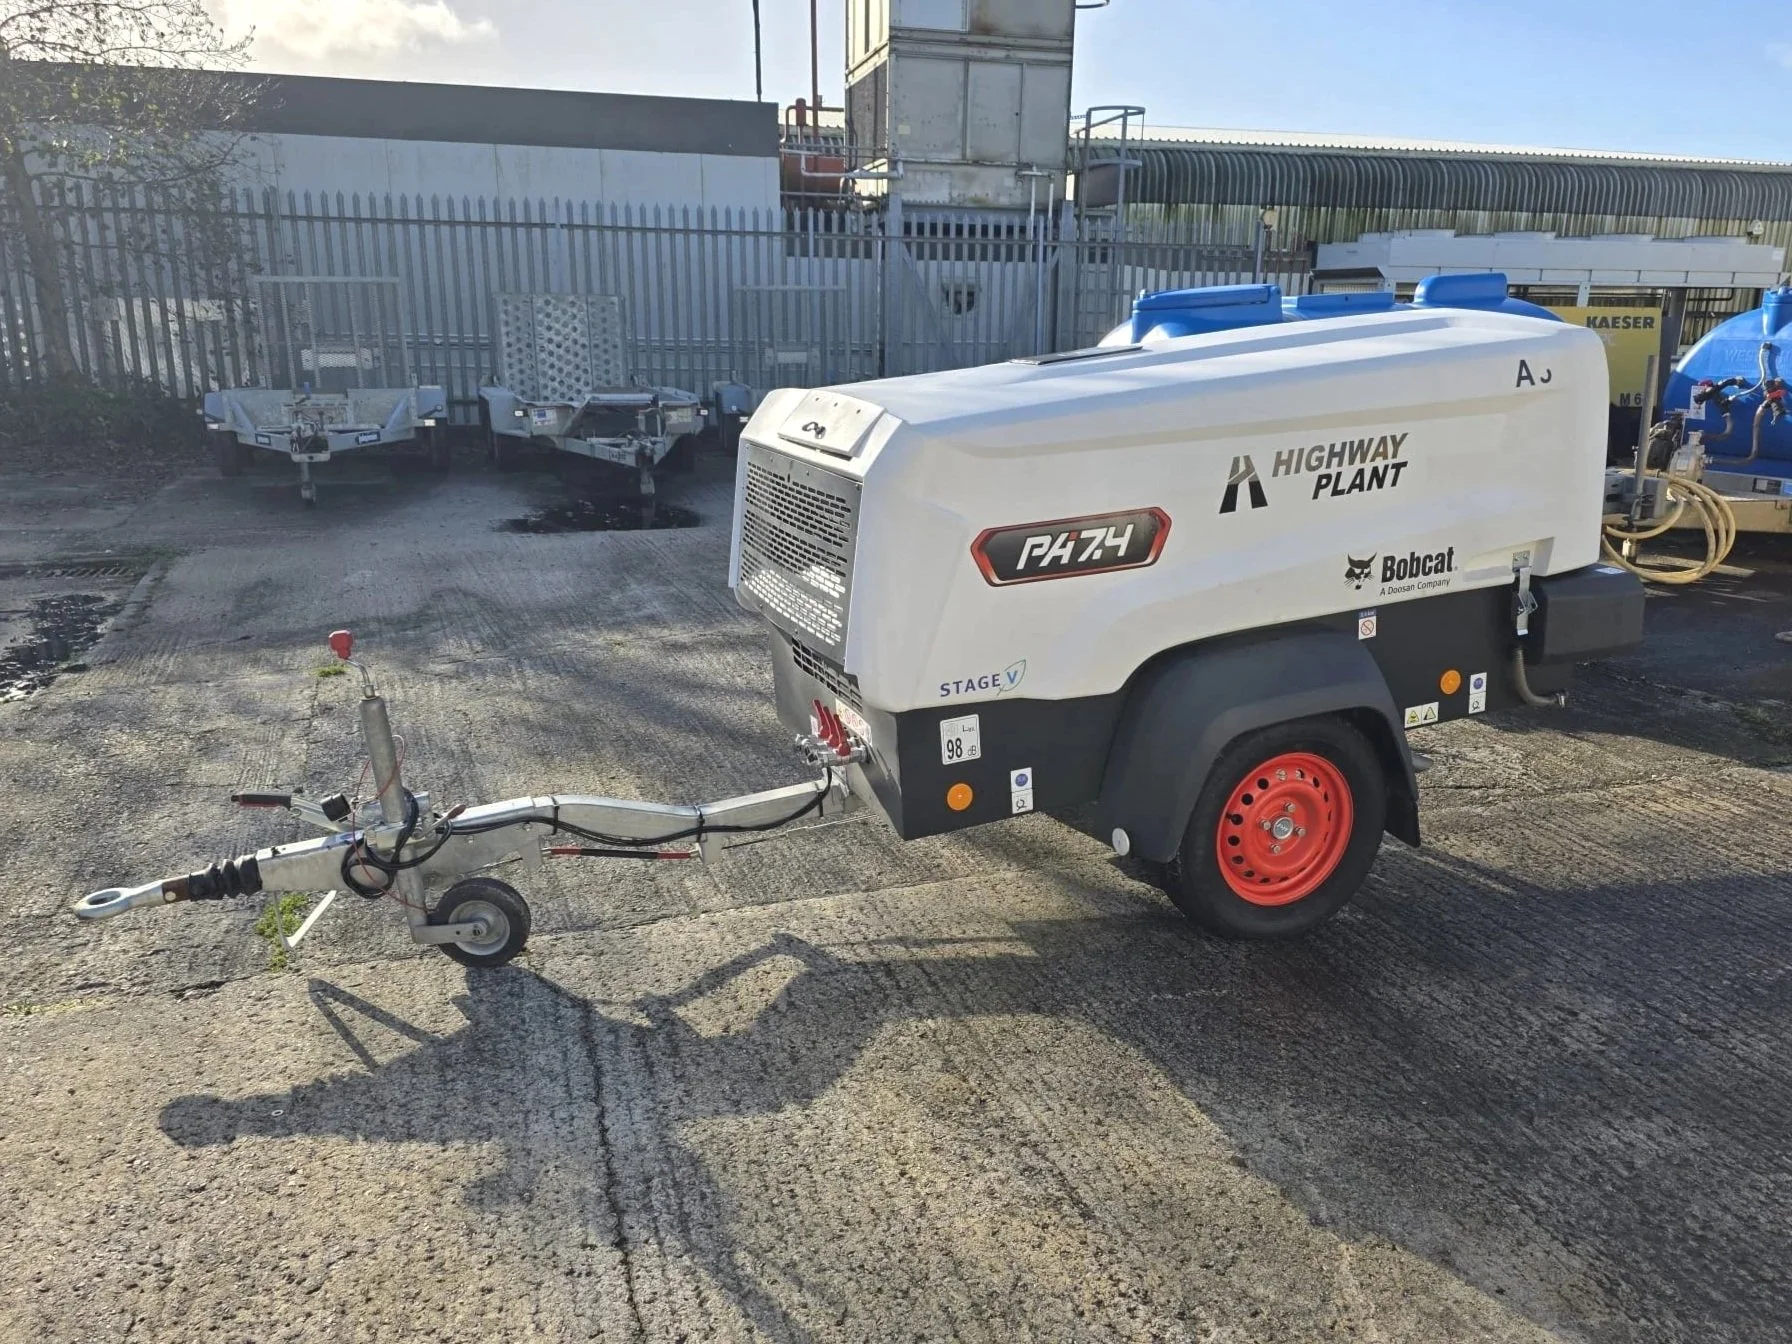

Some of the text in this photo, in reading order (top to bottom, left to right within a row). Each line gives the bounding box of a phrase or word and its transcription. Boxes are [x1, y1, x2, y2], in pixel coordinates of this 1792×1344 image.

[1586, 316, 1655, 329] KAESER
[1620, 393, 1631, 406] M
[1272, 432, 1409, 478] HIGHWAY
[1312, 461, 1408, 500] PLANT
[1381, 546, 1455, 583] Bobcat
[1379, 578, 1451, 596] A Doosan Company
[940, 670, 1018, 697] STAGE V
[947, 737, 963, 760] 98
